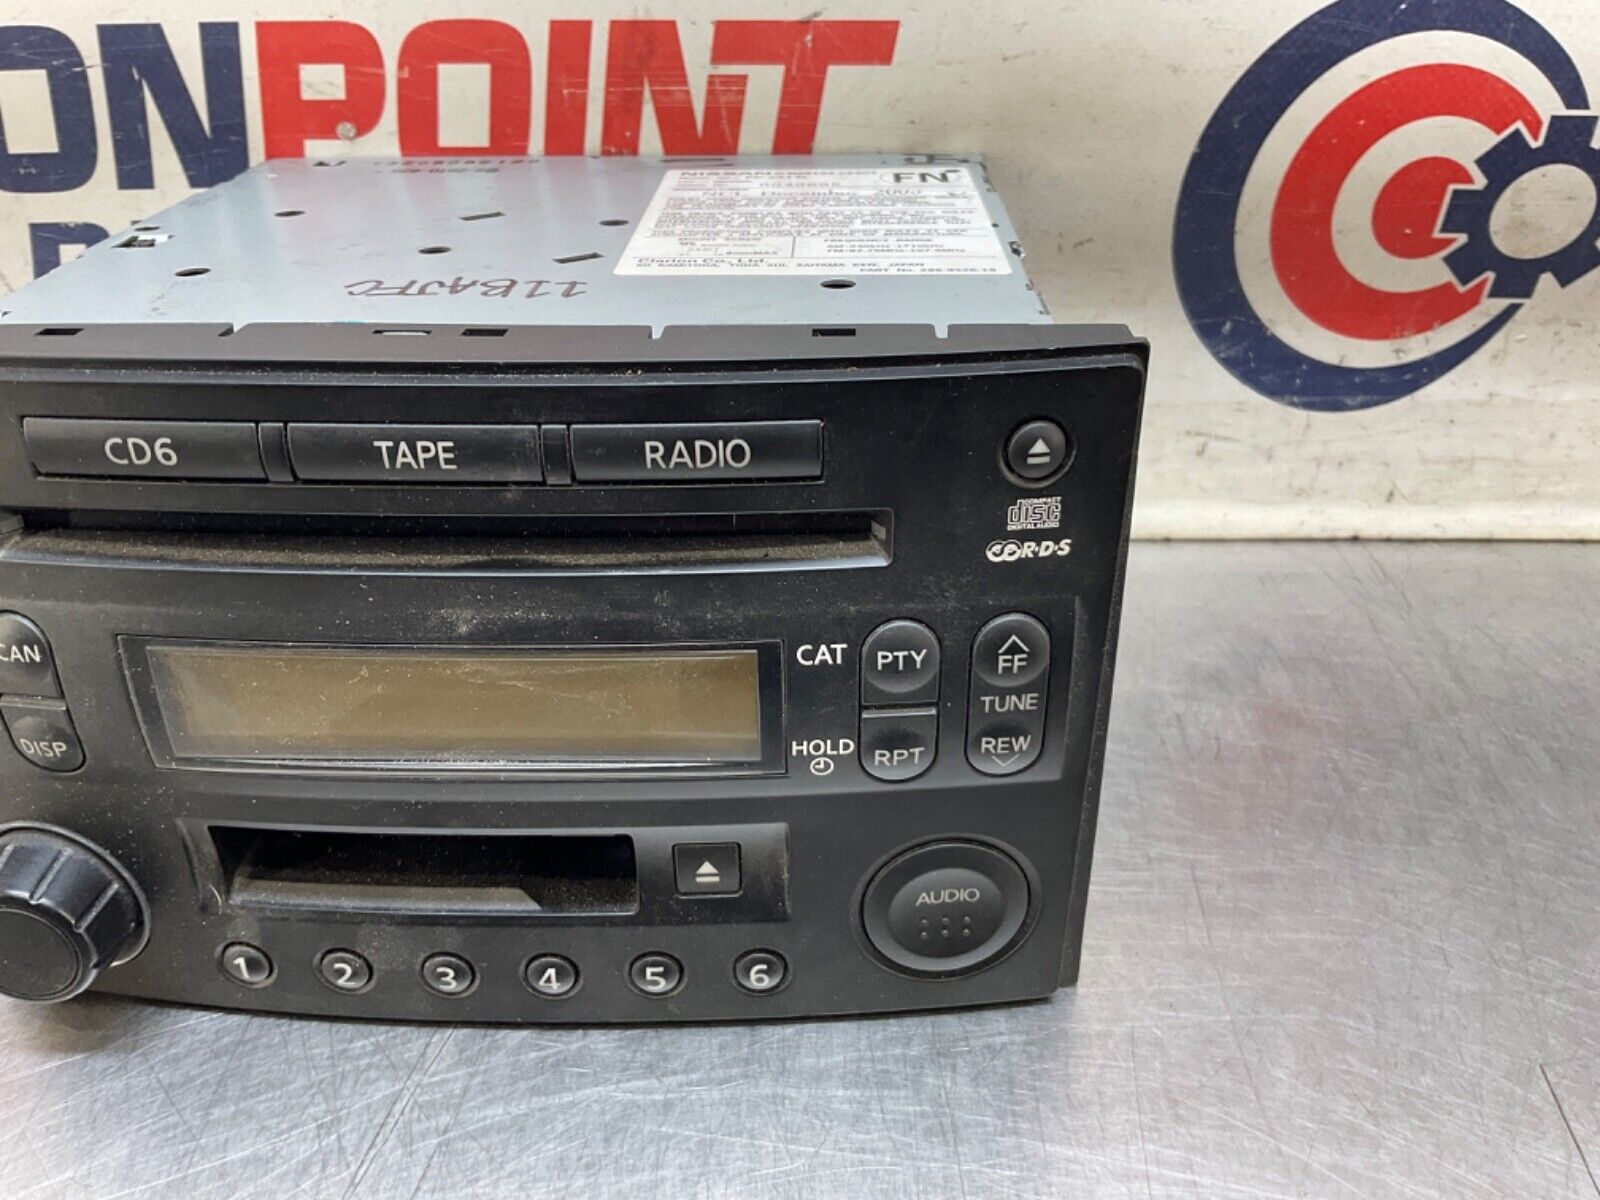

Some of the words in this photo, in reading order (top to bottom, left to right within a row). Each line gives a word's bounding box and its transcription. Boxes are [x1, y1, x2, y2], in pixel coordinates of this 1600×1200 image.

[893, 172, 949, 183] FN
[104, 437, 178, 466] CD6
[373, 441, 457, 469] TAPE
[644, 439, 752, 469] RADIO
[796, 644, 848, 666] CAT
[877, 649, 928, 671] PTY
[998, 654, 1028, 674] FF
[980, 693, 1039, 713] TUNE
[20, 738, 67, 758] DISP
[791, 739, 855, 757] HOLD
[981, 735, 1031, 755] REW
[873, 747, 925, 767] RPT
[916, 887, 980, 905] AUDIO
[233, 956, 250, 980] 1
[332, 963, 356, 986] 2
[435, 967, 456, 989] 3
[537, 967, 561, 990] 4
[645, 966, 666, 990] 5
[749, 964, 770, 988] 6
